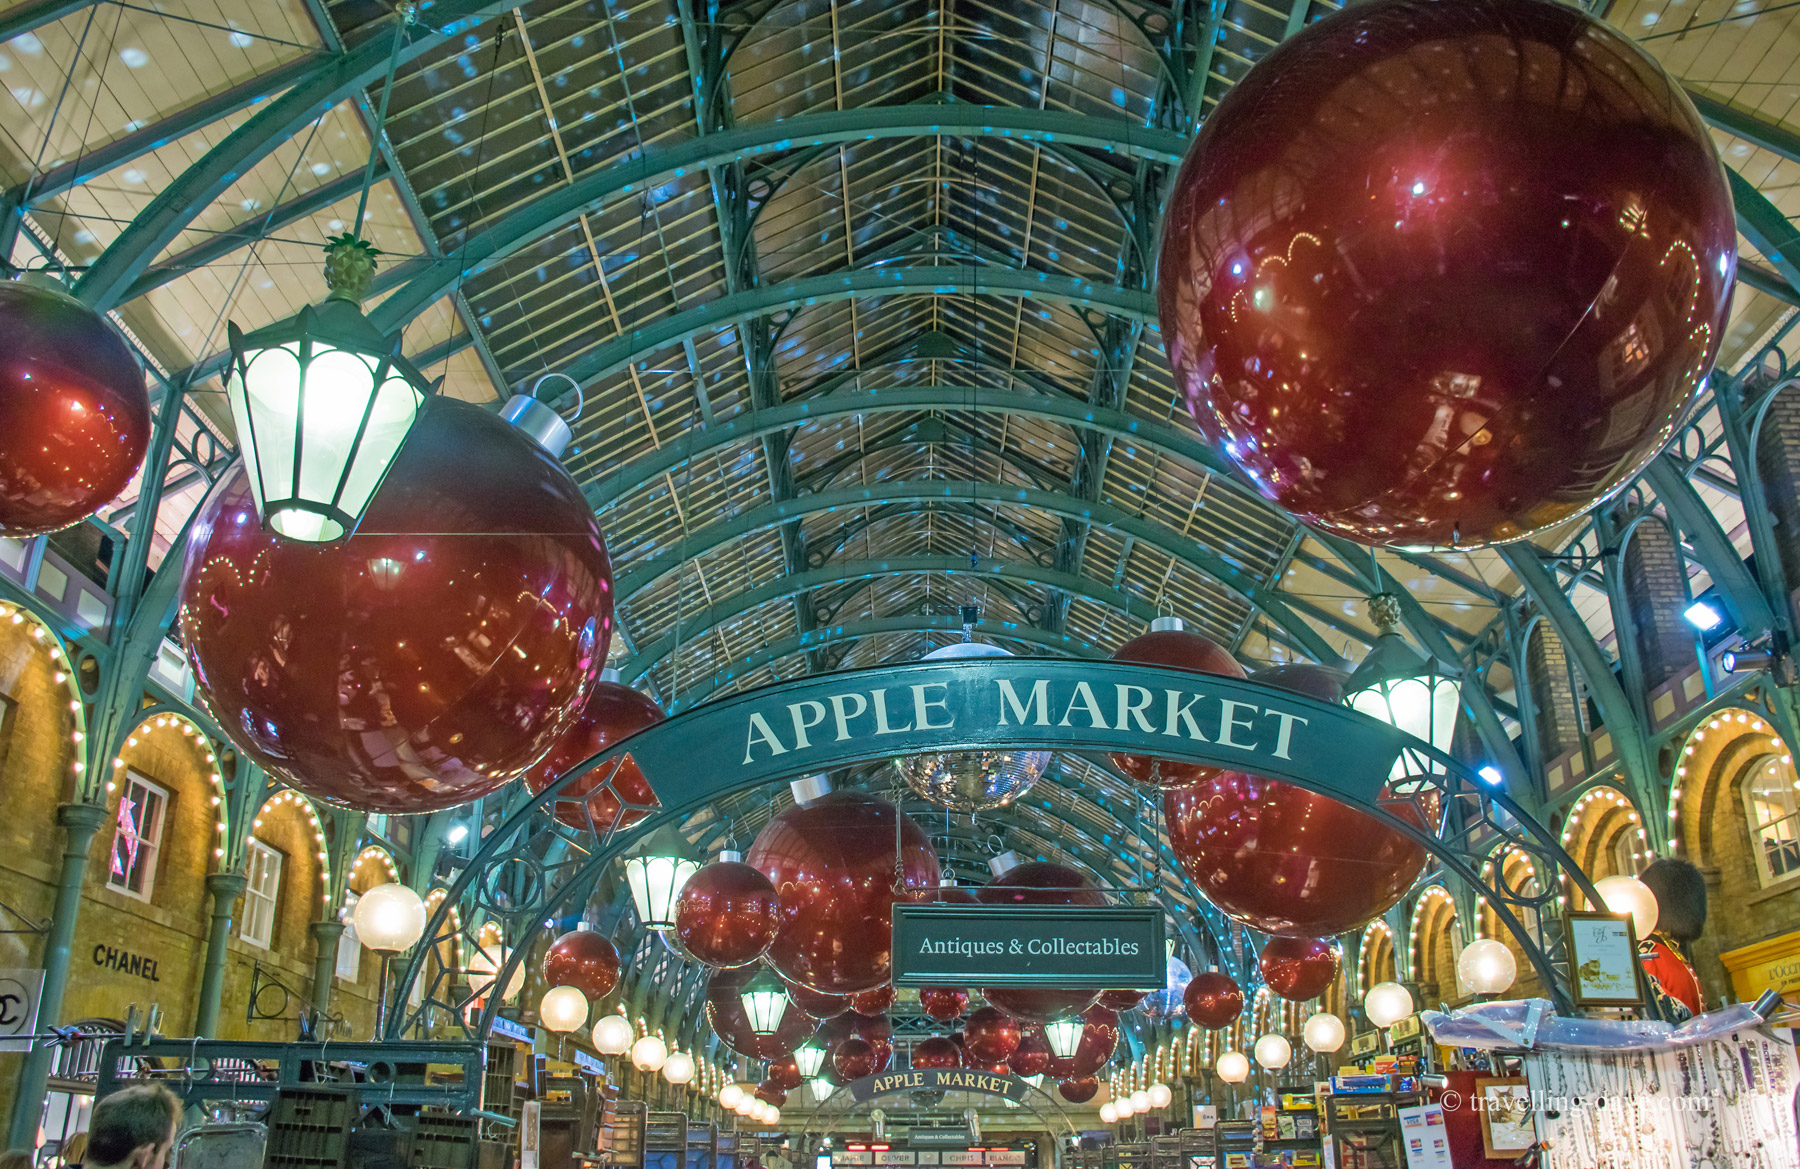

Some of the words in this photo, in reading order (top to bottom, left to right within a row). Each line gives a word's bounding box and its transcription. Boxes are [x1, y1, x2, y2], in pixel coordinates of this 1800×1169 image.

[742, 682, 955, 766] APPLE
[994, 679, 1309, 761] MARKET
[919, 937, 1004, 957] Antiques
[1008, 939, 1023, 954] &
[1028, 938, 1139, 955] Collectables
[93, 944, 160, 982] CHANEL
[873, 1073, 924, 1093] APPLE
[937, 1072, 1012, 1094] MARKET
